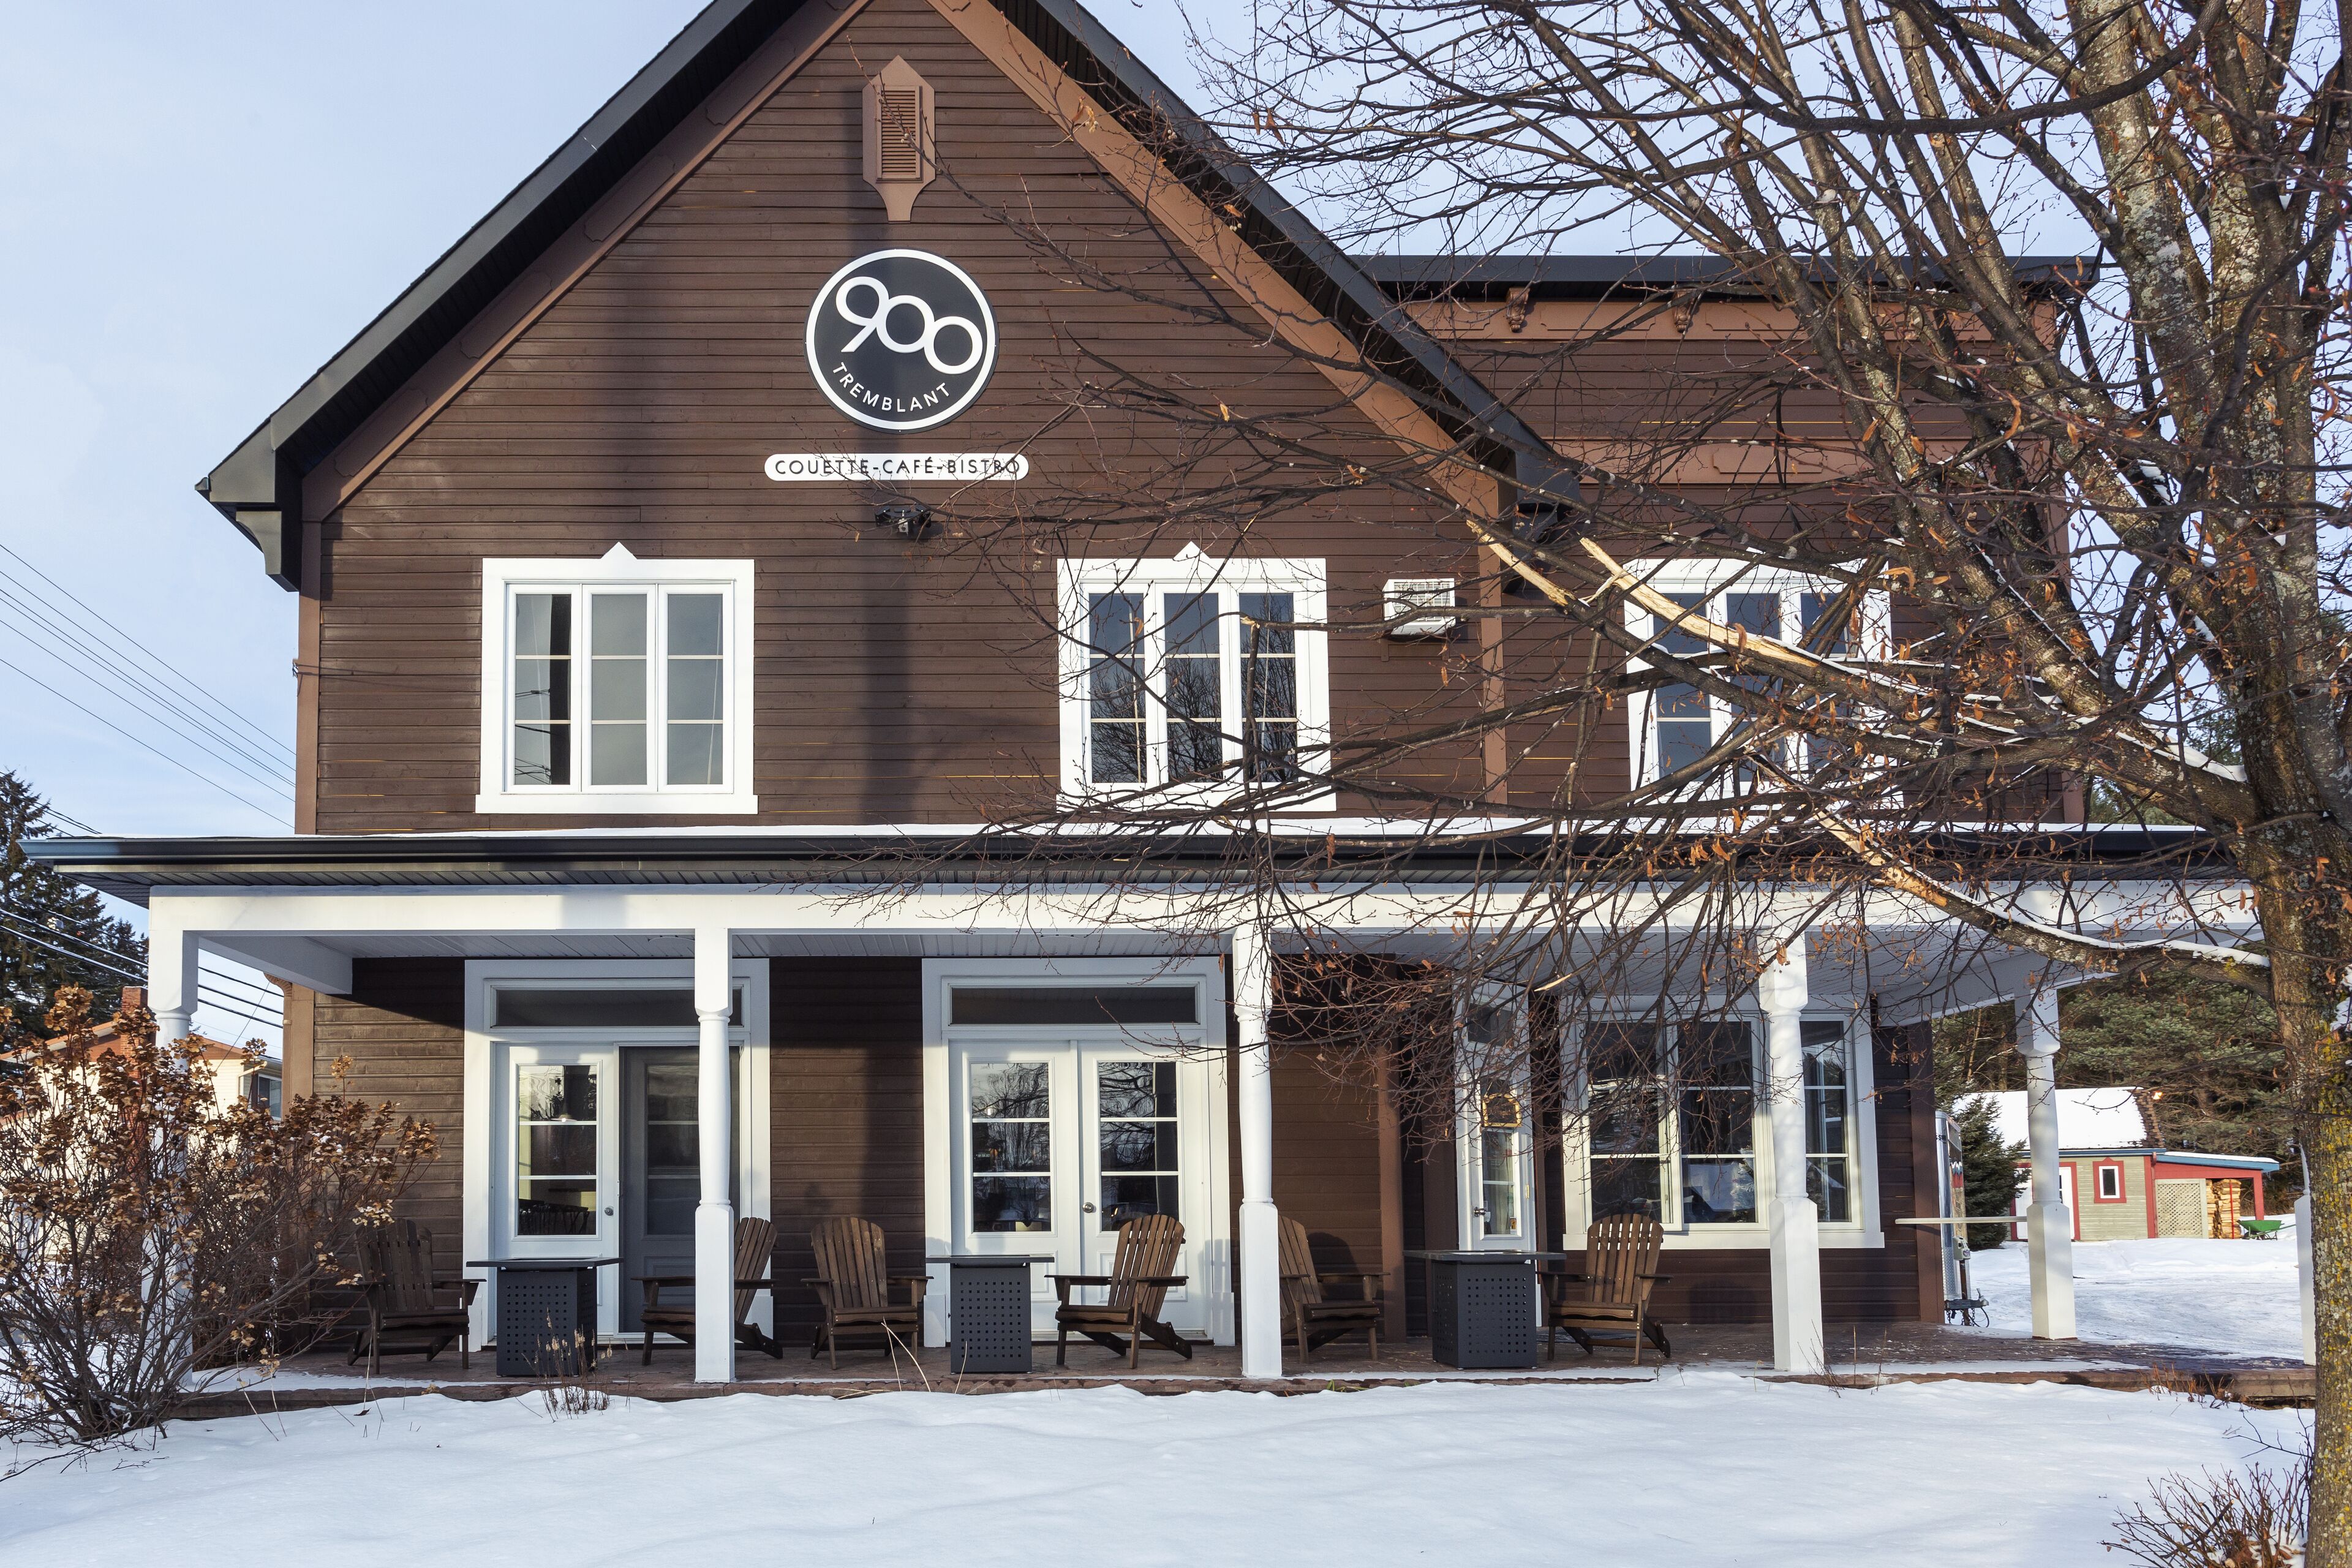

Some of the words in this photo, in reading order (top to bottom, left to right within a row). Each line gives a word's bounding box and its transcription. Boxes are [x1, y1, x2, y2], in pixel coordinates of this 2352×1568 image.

[835, 276, 983, 374] 900
[832, 362, 950, 412] TREMBLANT
[775, 457, 1020, 474] COUETTE-CAFÉ-BISTRO
